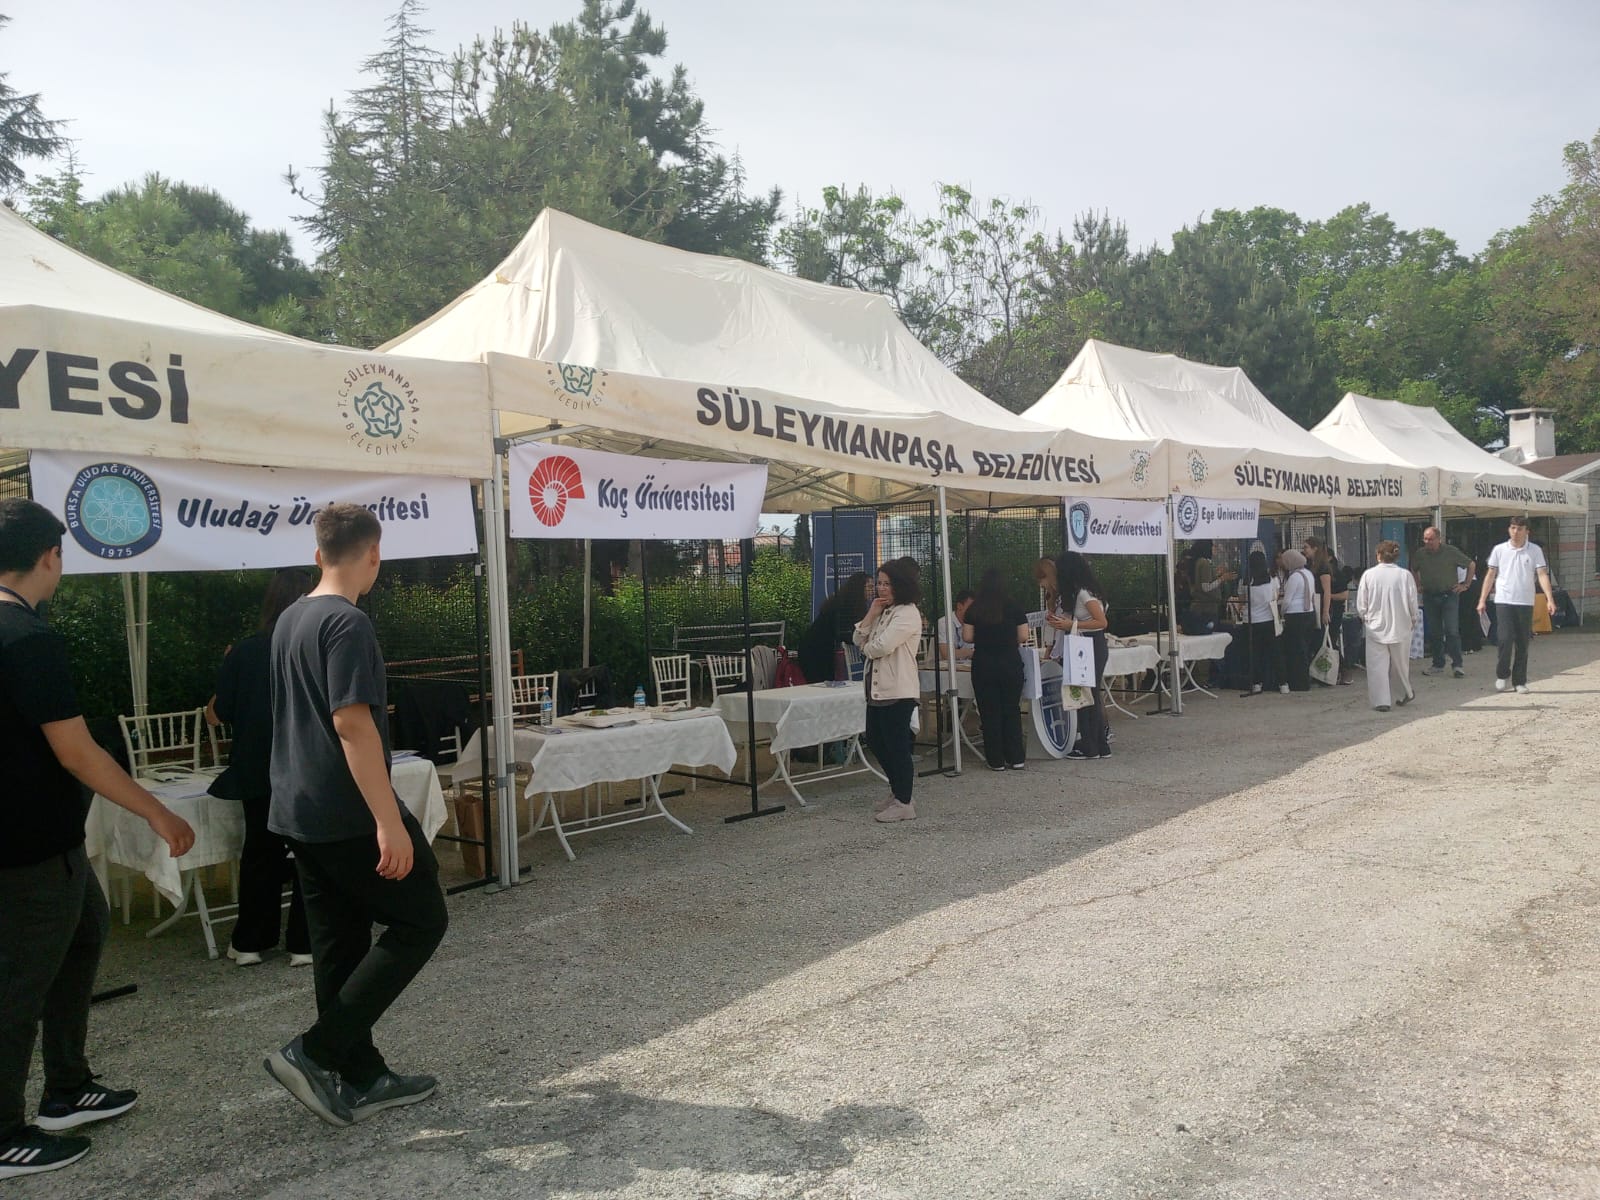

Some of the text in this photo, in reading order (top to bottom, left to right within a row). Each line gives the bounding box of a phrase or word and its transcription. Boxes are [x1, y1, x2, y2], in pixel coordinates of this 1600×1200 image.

[696, 386, 964, 477] SÜLEYMANPAŞA
[972, 447, 1100, 484] BELEDİYESİ
[67, 489, 81, 528] BURSA
[77, 463, 118, 487] ULUDAĞ
[598, 474, 735, 518] Koç Üniversitesi
[1234, 461, 1341, 499] SÜLEYMANPAŞA
[1347, 474, 1403, 498] BELEDİYESİ
[177, 498, 280, 536] Uludağ
[1089, 518, 1110, 536] Gazi
[1111, 515, 1162, 537] Üniversitesi
[1202, 506, 1215, 524] Ege
[1217, 503, 1256, 521] Üniversitesi
[100, 547, 133, 557] 1975
